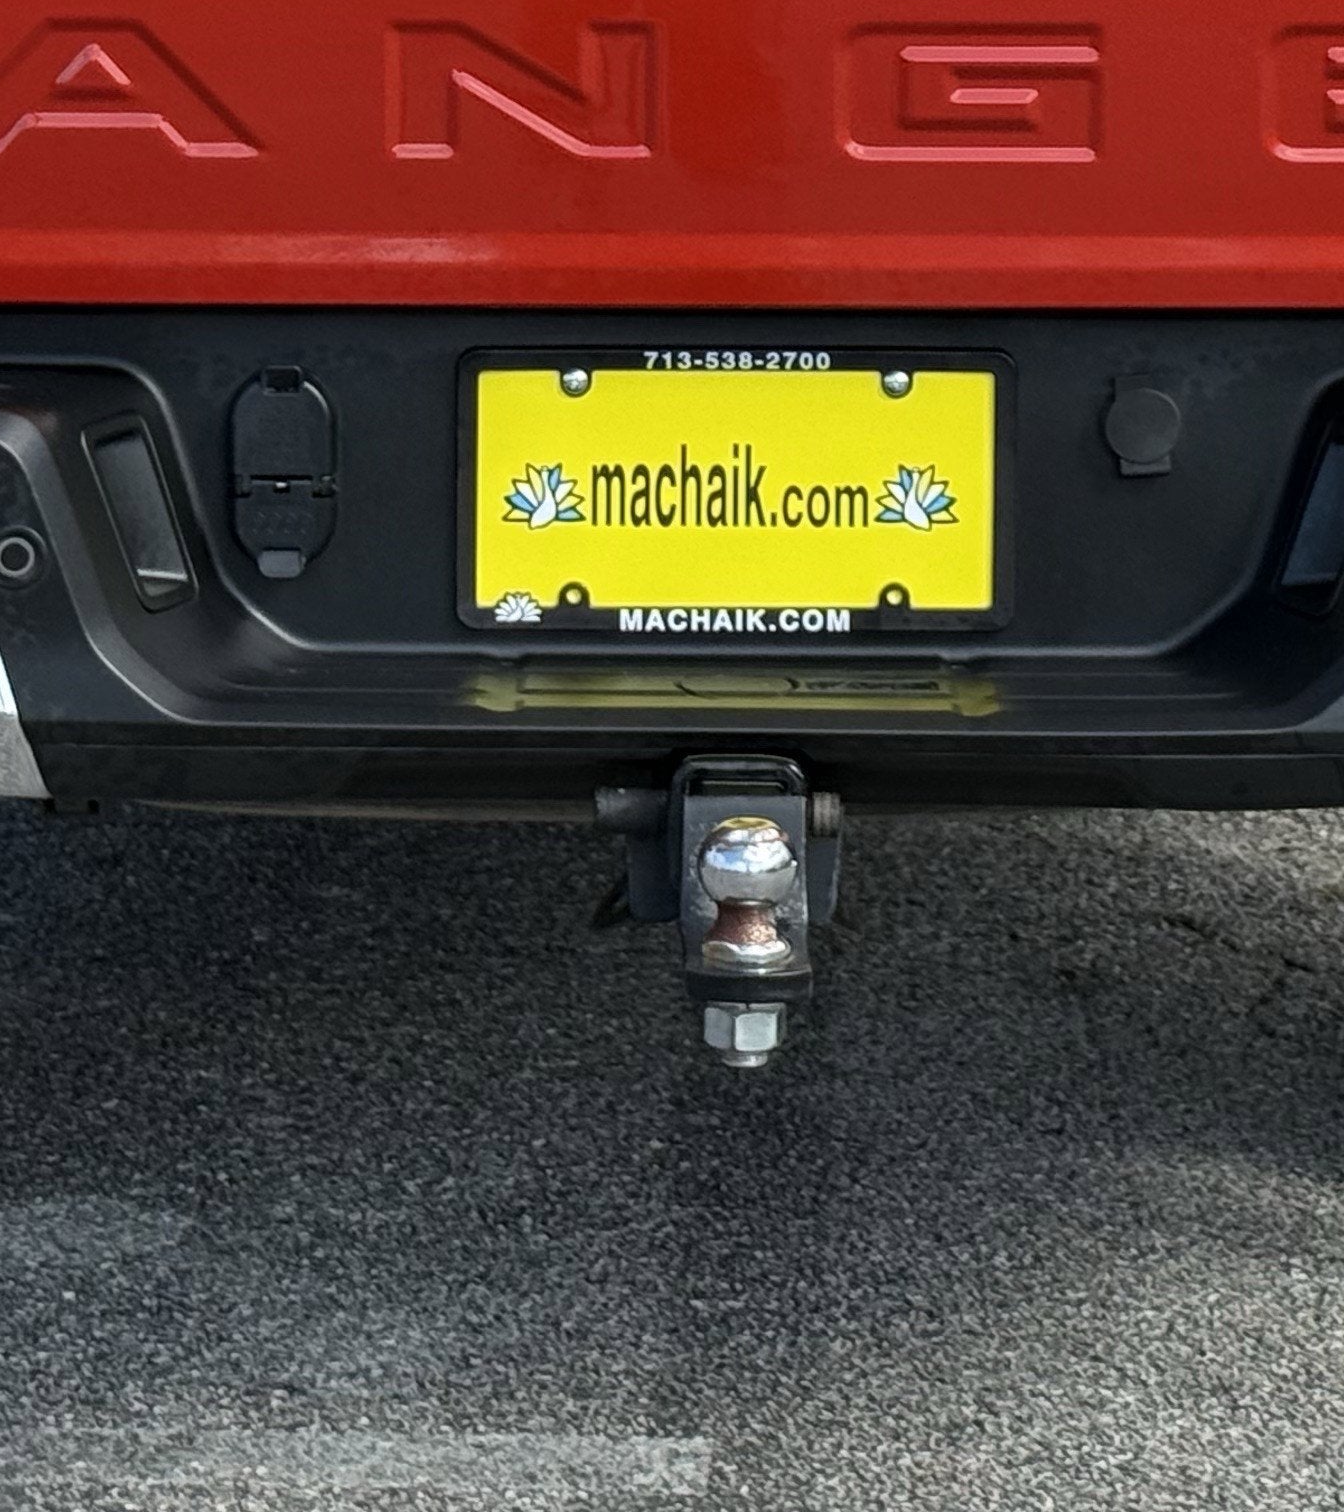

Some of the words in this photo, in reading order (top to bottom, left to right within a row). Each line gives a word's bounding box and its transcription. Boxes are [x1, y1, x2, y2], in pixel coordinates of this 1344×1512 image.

[643, 351, 832, 371] 713-538-2700
[590, 443, 870, 529] machaik.com
[618, 607, 852, 634] MACHAIK.COM
